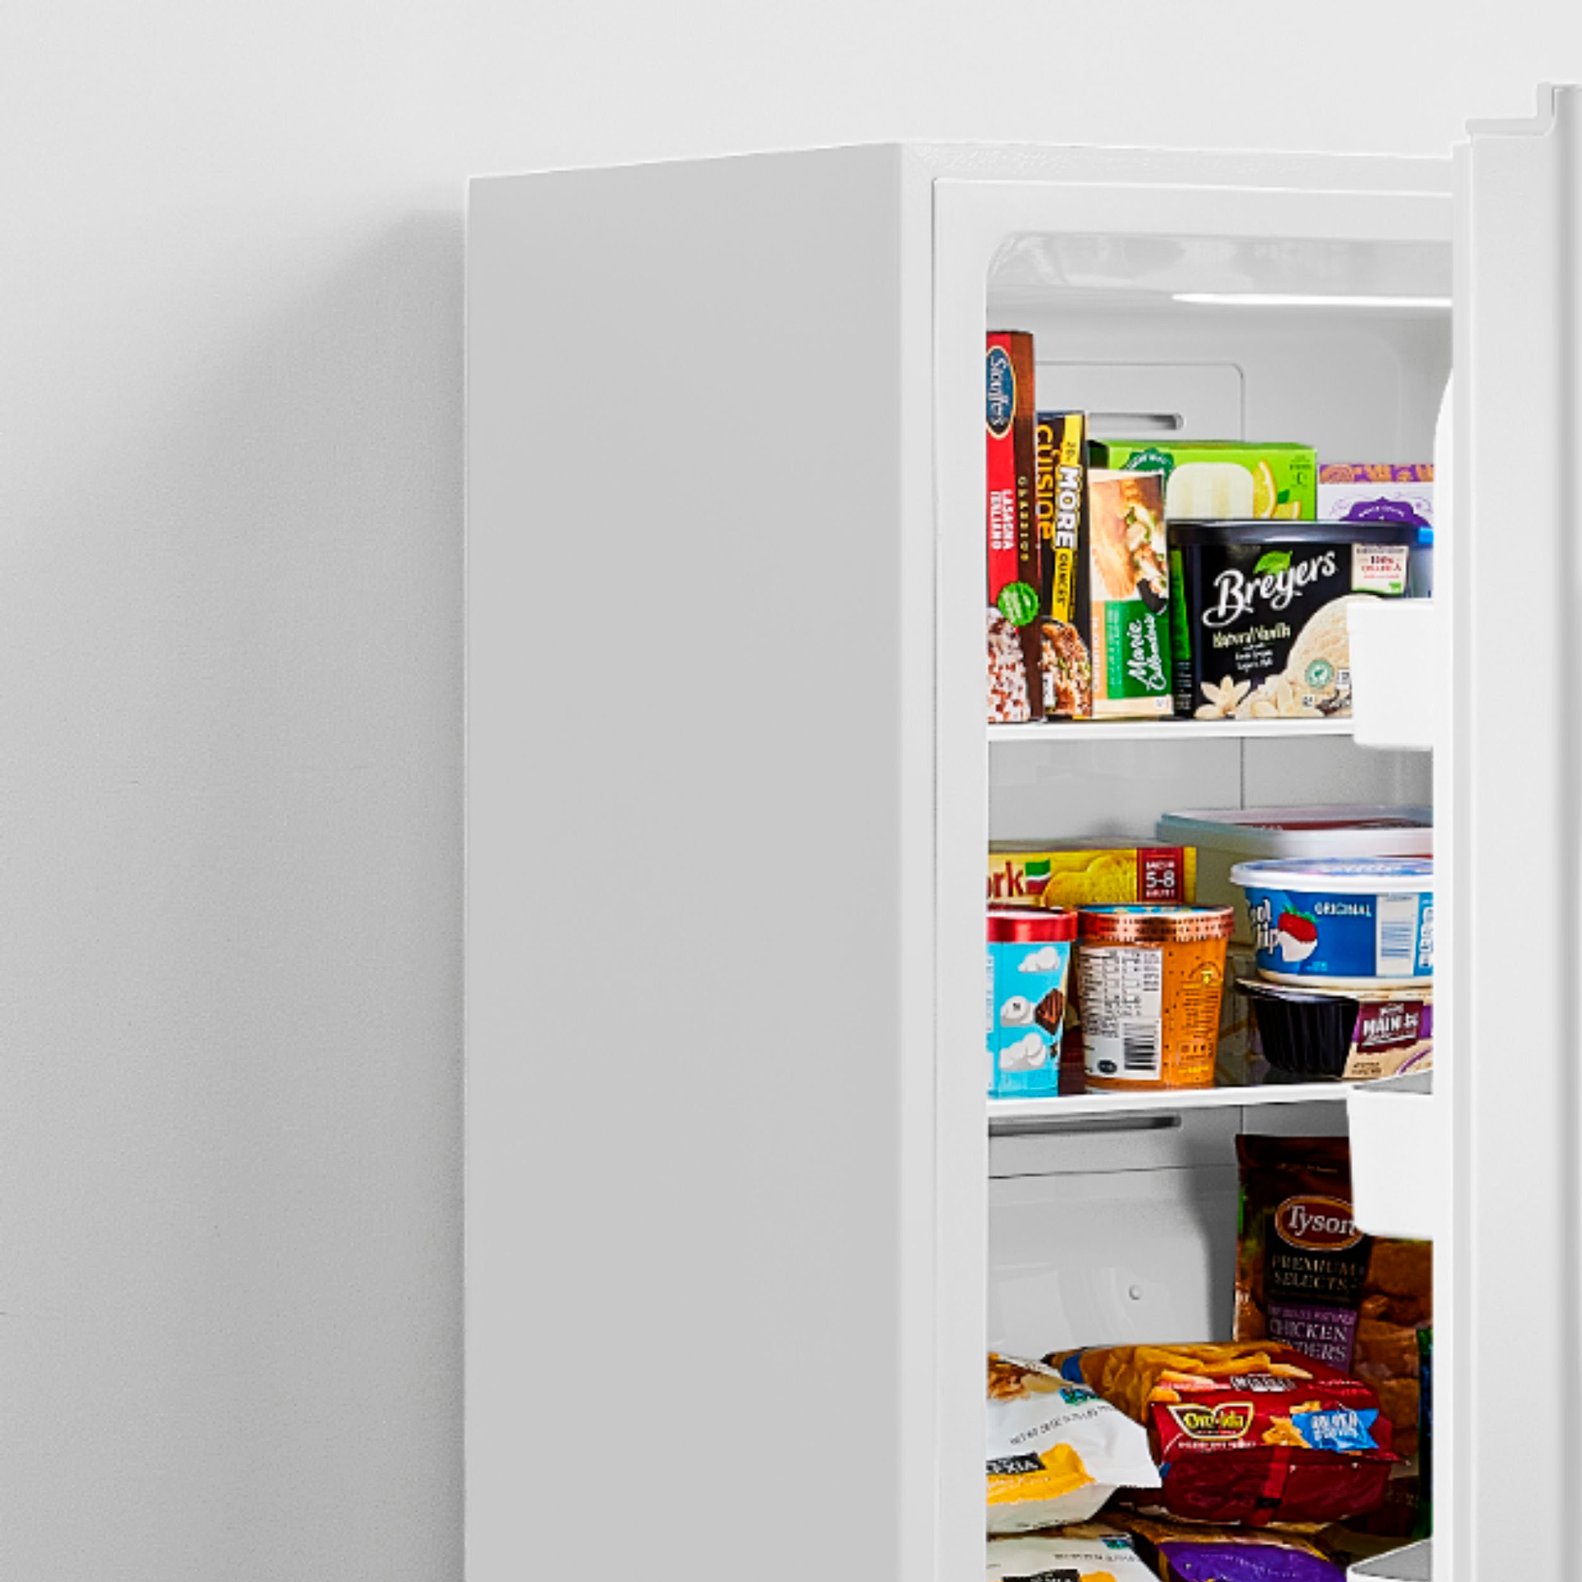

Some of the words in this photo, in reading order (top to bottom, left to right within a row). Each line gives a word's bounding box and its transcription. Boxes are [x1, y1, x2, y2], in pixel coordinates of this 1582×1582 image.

[1056, 466, 1079, 549] MORE
[1202, 551, 1337, 627] Breyers
[1126, 618, 1149, 684] Marie
[1146, 871, 1176, 889] 5-8
[1363, 1015, 1402, 1037] MAIN
[1288, 1204, 1355, 1237] Tyson
[1271, 1253, 1356, 1277] PREMIUM
[1270, 1319, 1348, 1342] CHICKEN
